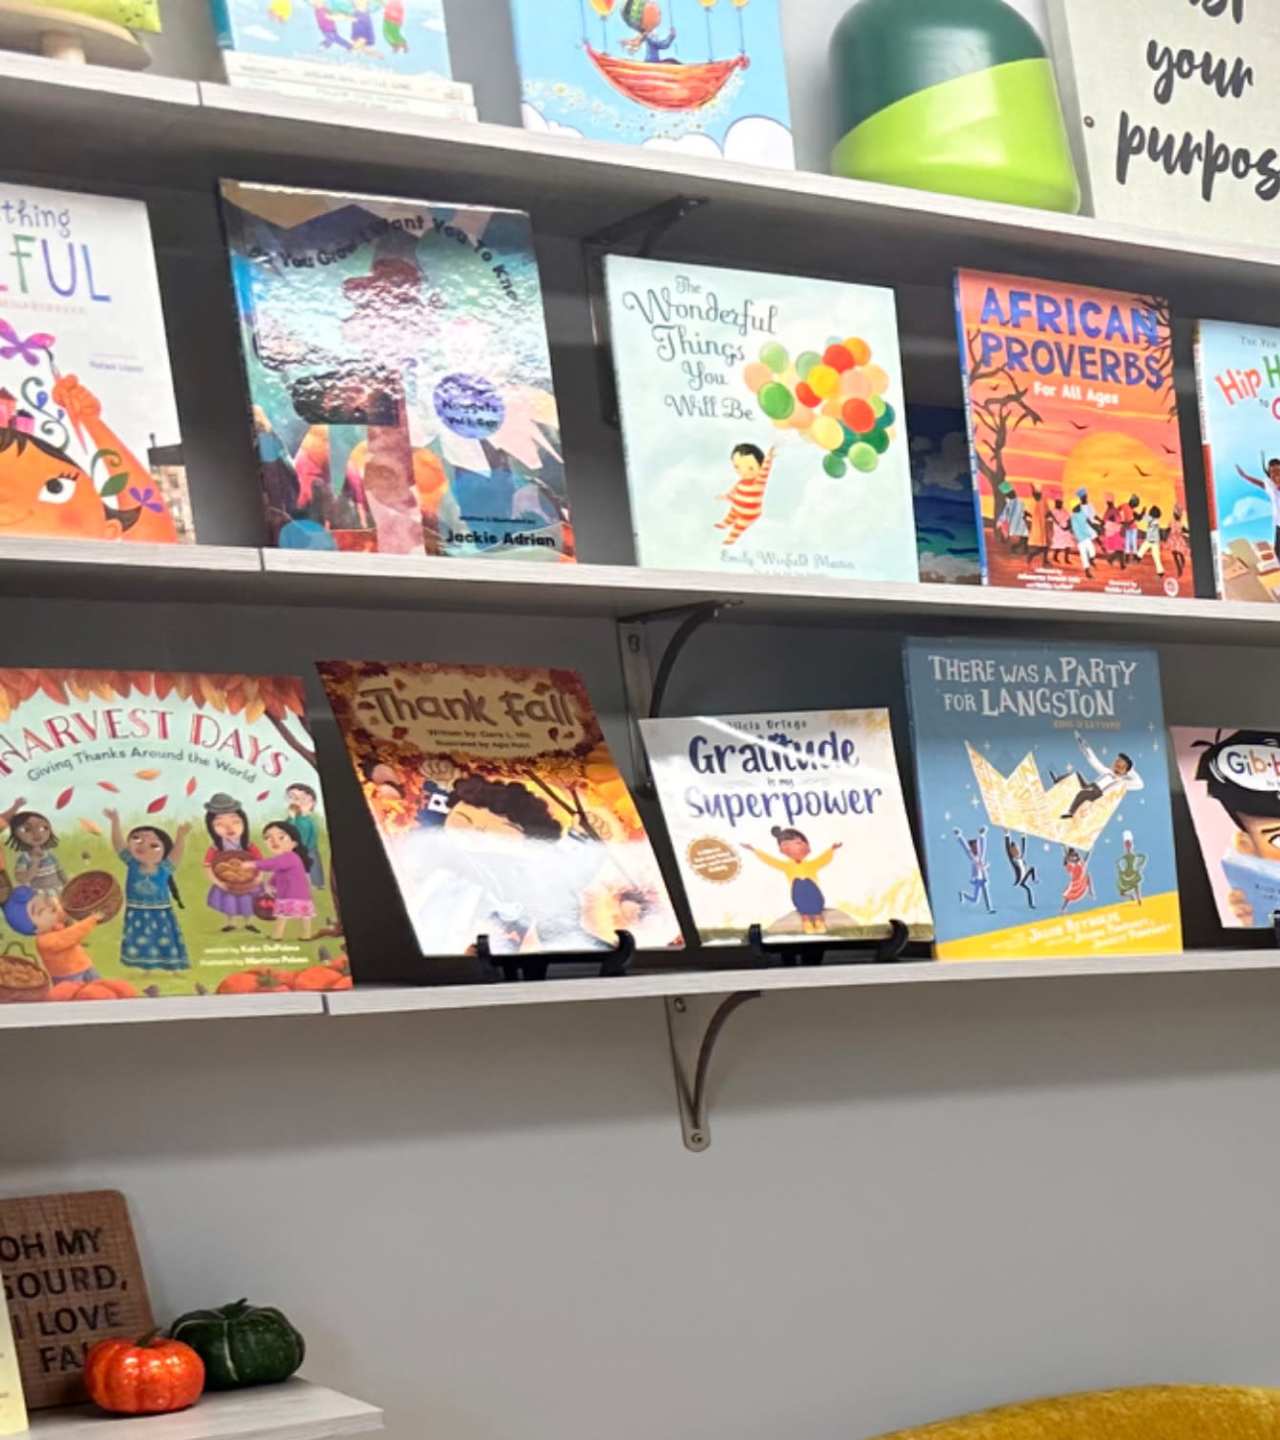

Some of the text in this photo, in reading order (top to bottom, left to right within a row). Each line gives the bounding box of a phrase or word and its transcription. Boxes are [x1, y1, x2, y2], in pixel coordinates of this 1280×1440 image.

[1147, 39, 1254, 105] your
[0, 233, 111, 302] FUL
[675, 275, 702, 294] The
[622, 286, 778, 336] Wonderful
[980, 287, 1160, 347] AFRICAN
[651, 324, 746, 367] Things
[979, 331, 1166, 391] PROVERBS
[681, 360, 729, 391] You
[1033, 381, 1120, 409] For All Ages
[1215, 367, 1263, 406] Hip
[664, 394, 756, 422] Will Be
[446, 529, 556, 547] Jackie Adrian
[928, 655, 1138, 688] THERE WAS A PARTY
[360, 687, 576, 727] Thank Fall
[943, 687, 1115, 718] FOR LANGSTON
[189, 711, 291, 779] DAYS
[26, 746, 258, 785] Giving Thanks Around the World
[685, 784, 883, 828] Superpower
[0, 1226, 103, 1263] OH MY
[13, 1302, 125, 1340] I LOVE
[40, 1341, 88, 1373] FA
